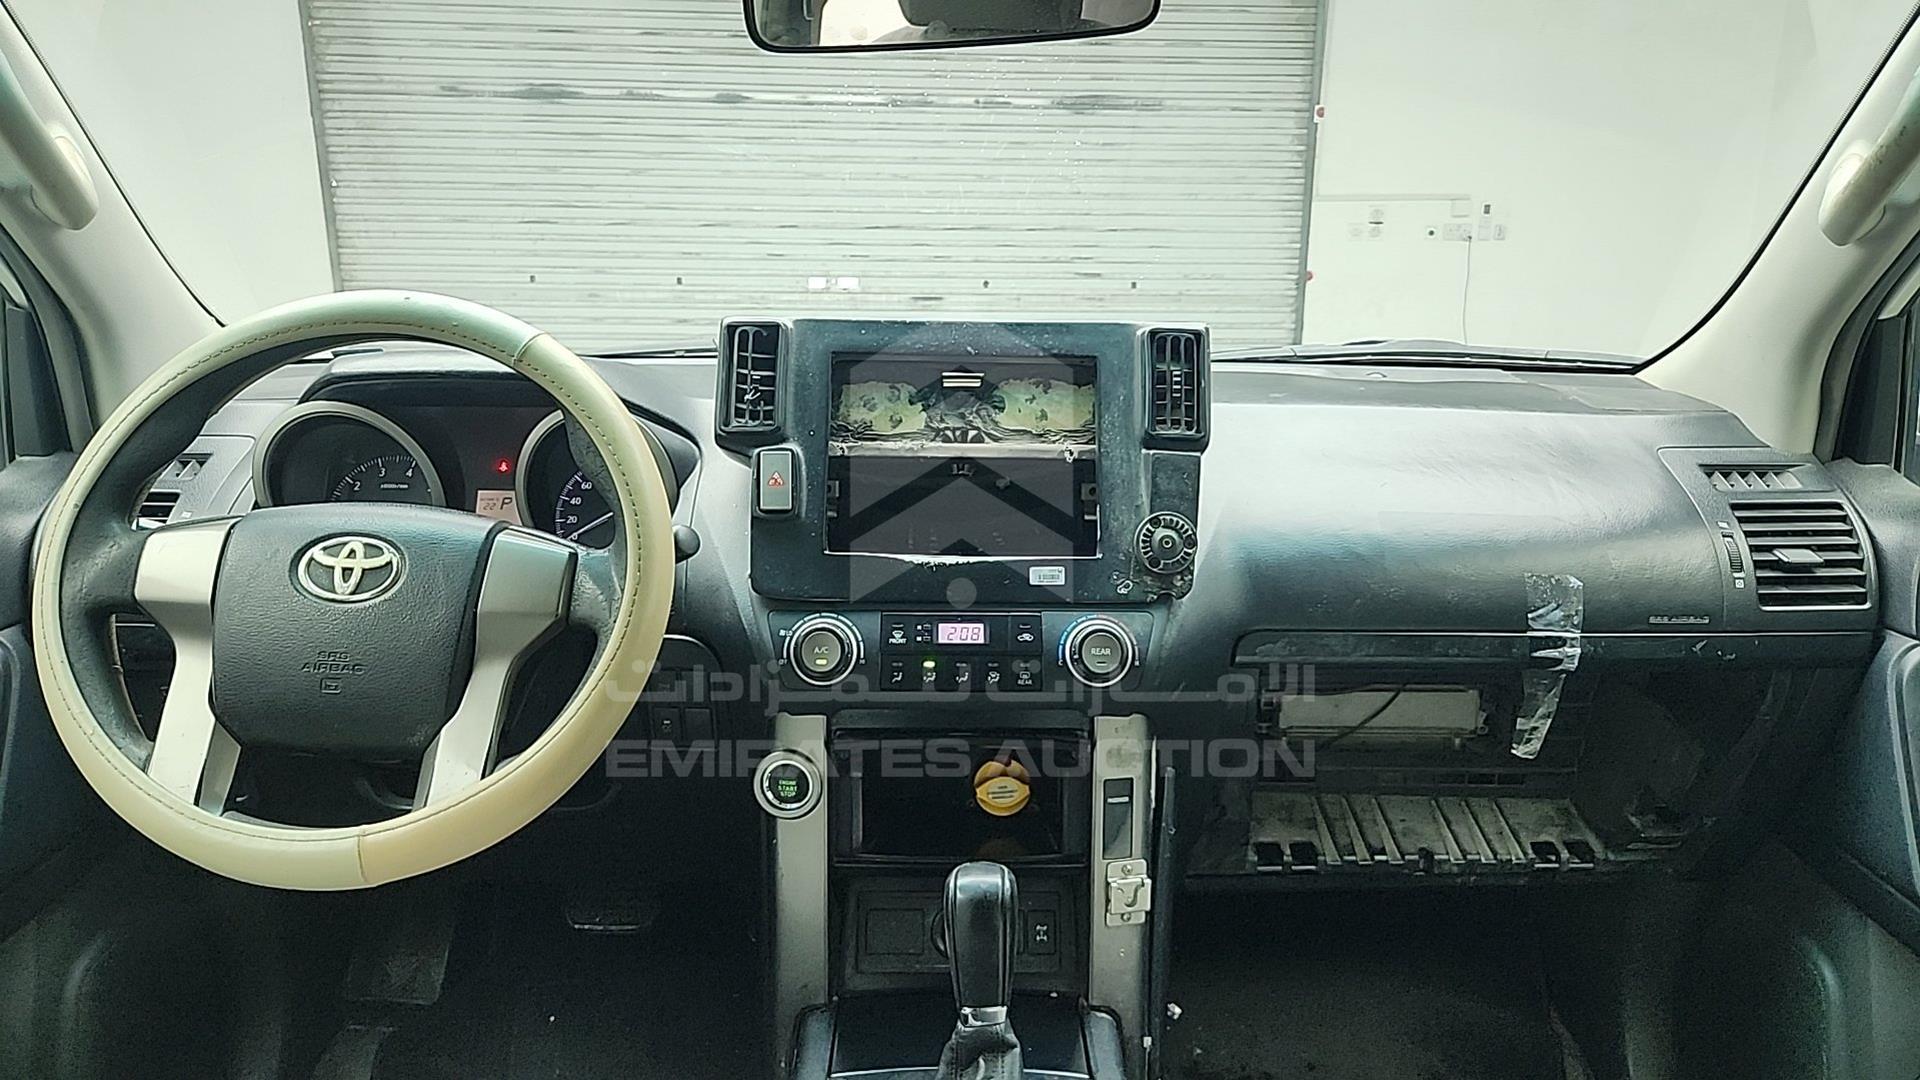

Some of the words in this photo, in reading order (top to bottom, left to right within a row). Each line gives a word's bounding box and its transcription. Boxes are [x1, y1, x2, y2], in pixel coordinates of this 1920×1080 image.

[379, 467, 386, 477] 3
[405, 468, 413, 477] 4
[353, 481, 361, 491] 2
[580, 481, 593, 490] 60
[500, 497, 513, 510] P
[569, 496, 582, 505] 40
[566, 515, 578, 524] 20
[946, 626, 981, 641] 208
[813, 646, 830, 654] A/C
[1090, 647, 1111, 656] REAR
